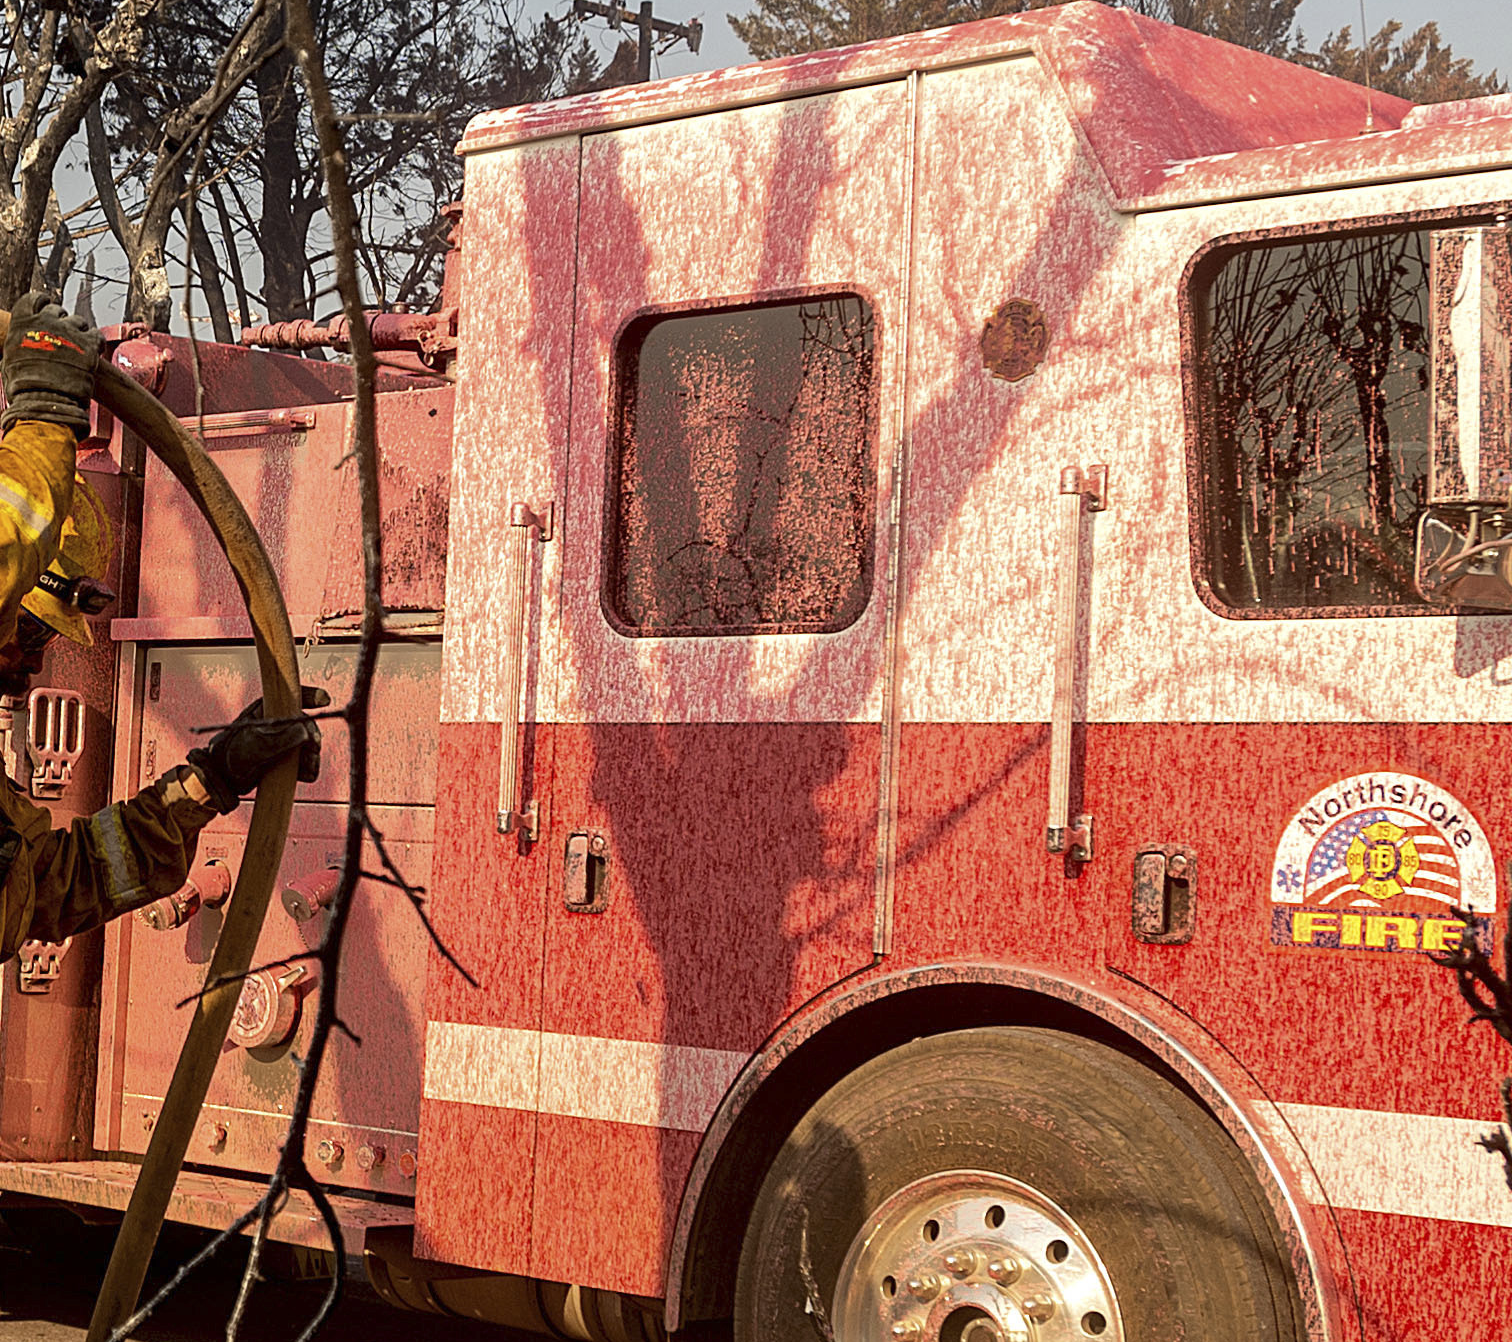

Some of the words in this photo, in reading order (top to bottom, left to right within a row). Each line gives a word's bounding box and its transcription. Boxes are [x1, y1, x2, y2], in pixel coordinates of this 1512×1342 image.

[1298, 778, 1472, 849] Northshore
[1349, 853, 1361, 865] 80
[1375, 884, 1389, 896] 90
[1292, 911, 1468, 951] FIRE
